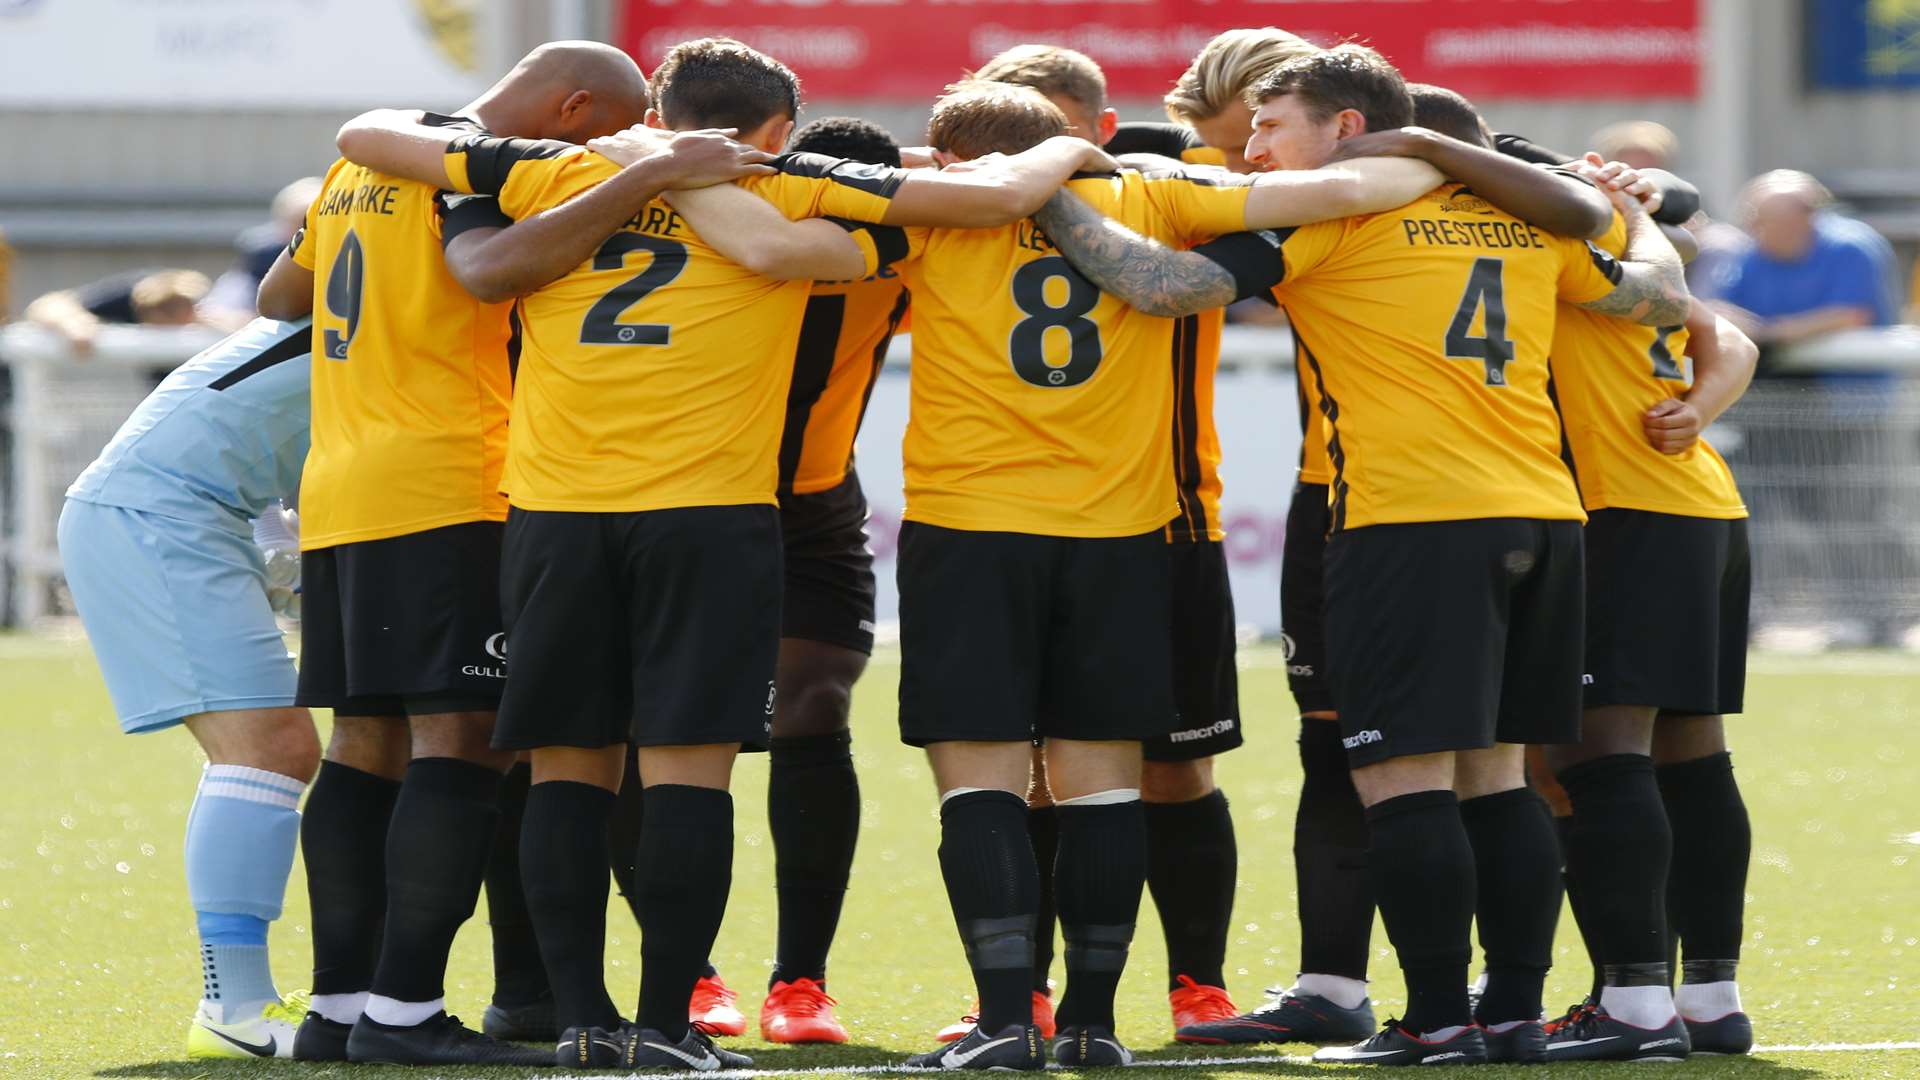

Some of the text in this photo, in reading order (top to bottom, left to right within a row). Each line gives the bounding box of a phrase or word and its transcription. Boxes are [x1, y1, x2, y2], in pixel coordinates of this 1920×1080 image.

[621, 207, 681, 237] ARE
[1018, 222, 1055, 251] LE
[1403, 219, 1544, 248] PRESTEDGE
[323, 227, 365, 360] 9
[579, 230, 689, 346] 2
[1009, 255, 1104, 389] 8
[1445, 257, 1515, 386] 4
[462, 665, 508, 678] GULL
[1169, 719, 1233, 743] macron
